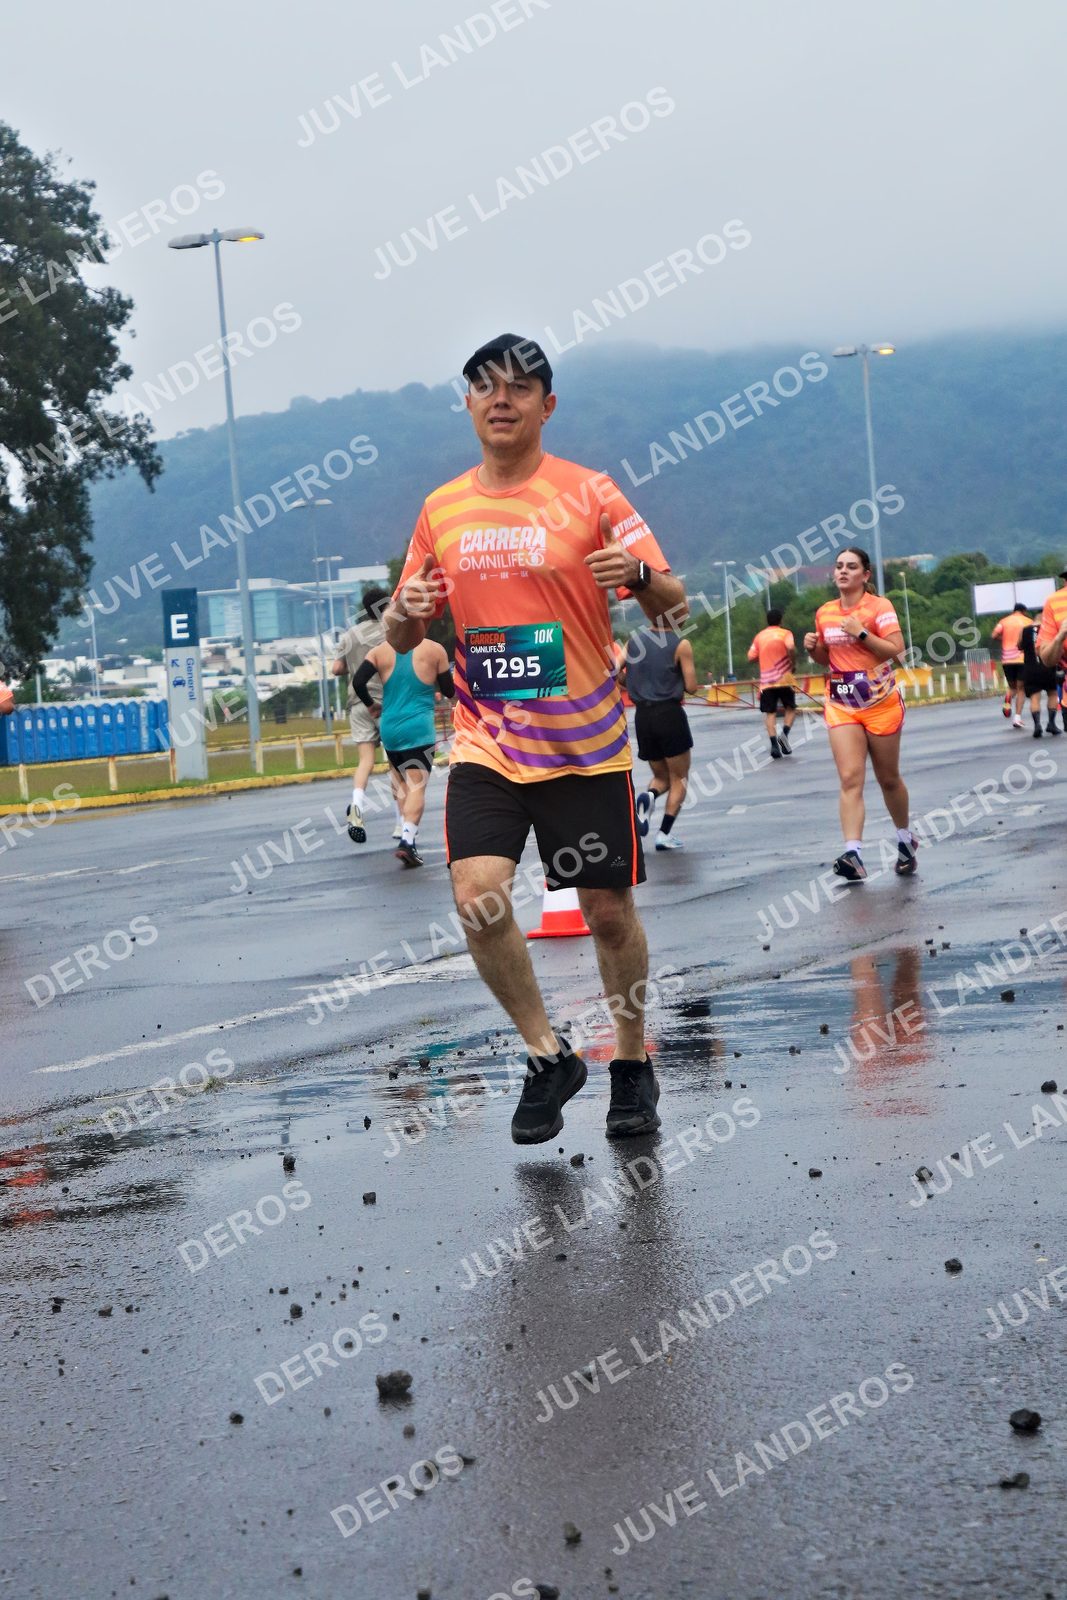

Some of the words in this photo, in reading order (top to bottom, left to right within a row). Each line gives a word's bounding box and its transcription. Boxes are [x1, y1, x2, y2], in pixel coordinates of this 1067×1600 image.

[460, 526, 547, 554] CARRERA
[460, 553, 525, 572] OMNILIFE
[170, 613, 190, 639] E
[470, 632, 506, 645] CARRERA
[534, 628, 554, 644] 10K
[470, 645, 497, 654] OMNILIFE
[482, 656, 541, 679] 1295
[186, 657, 197, 700] General
[837, 685, 854, 694] 687
